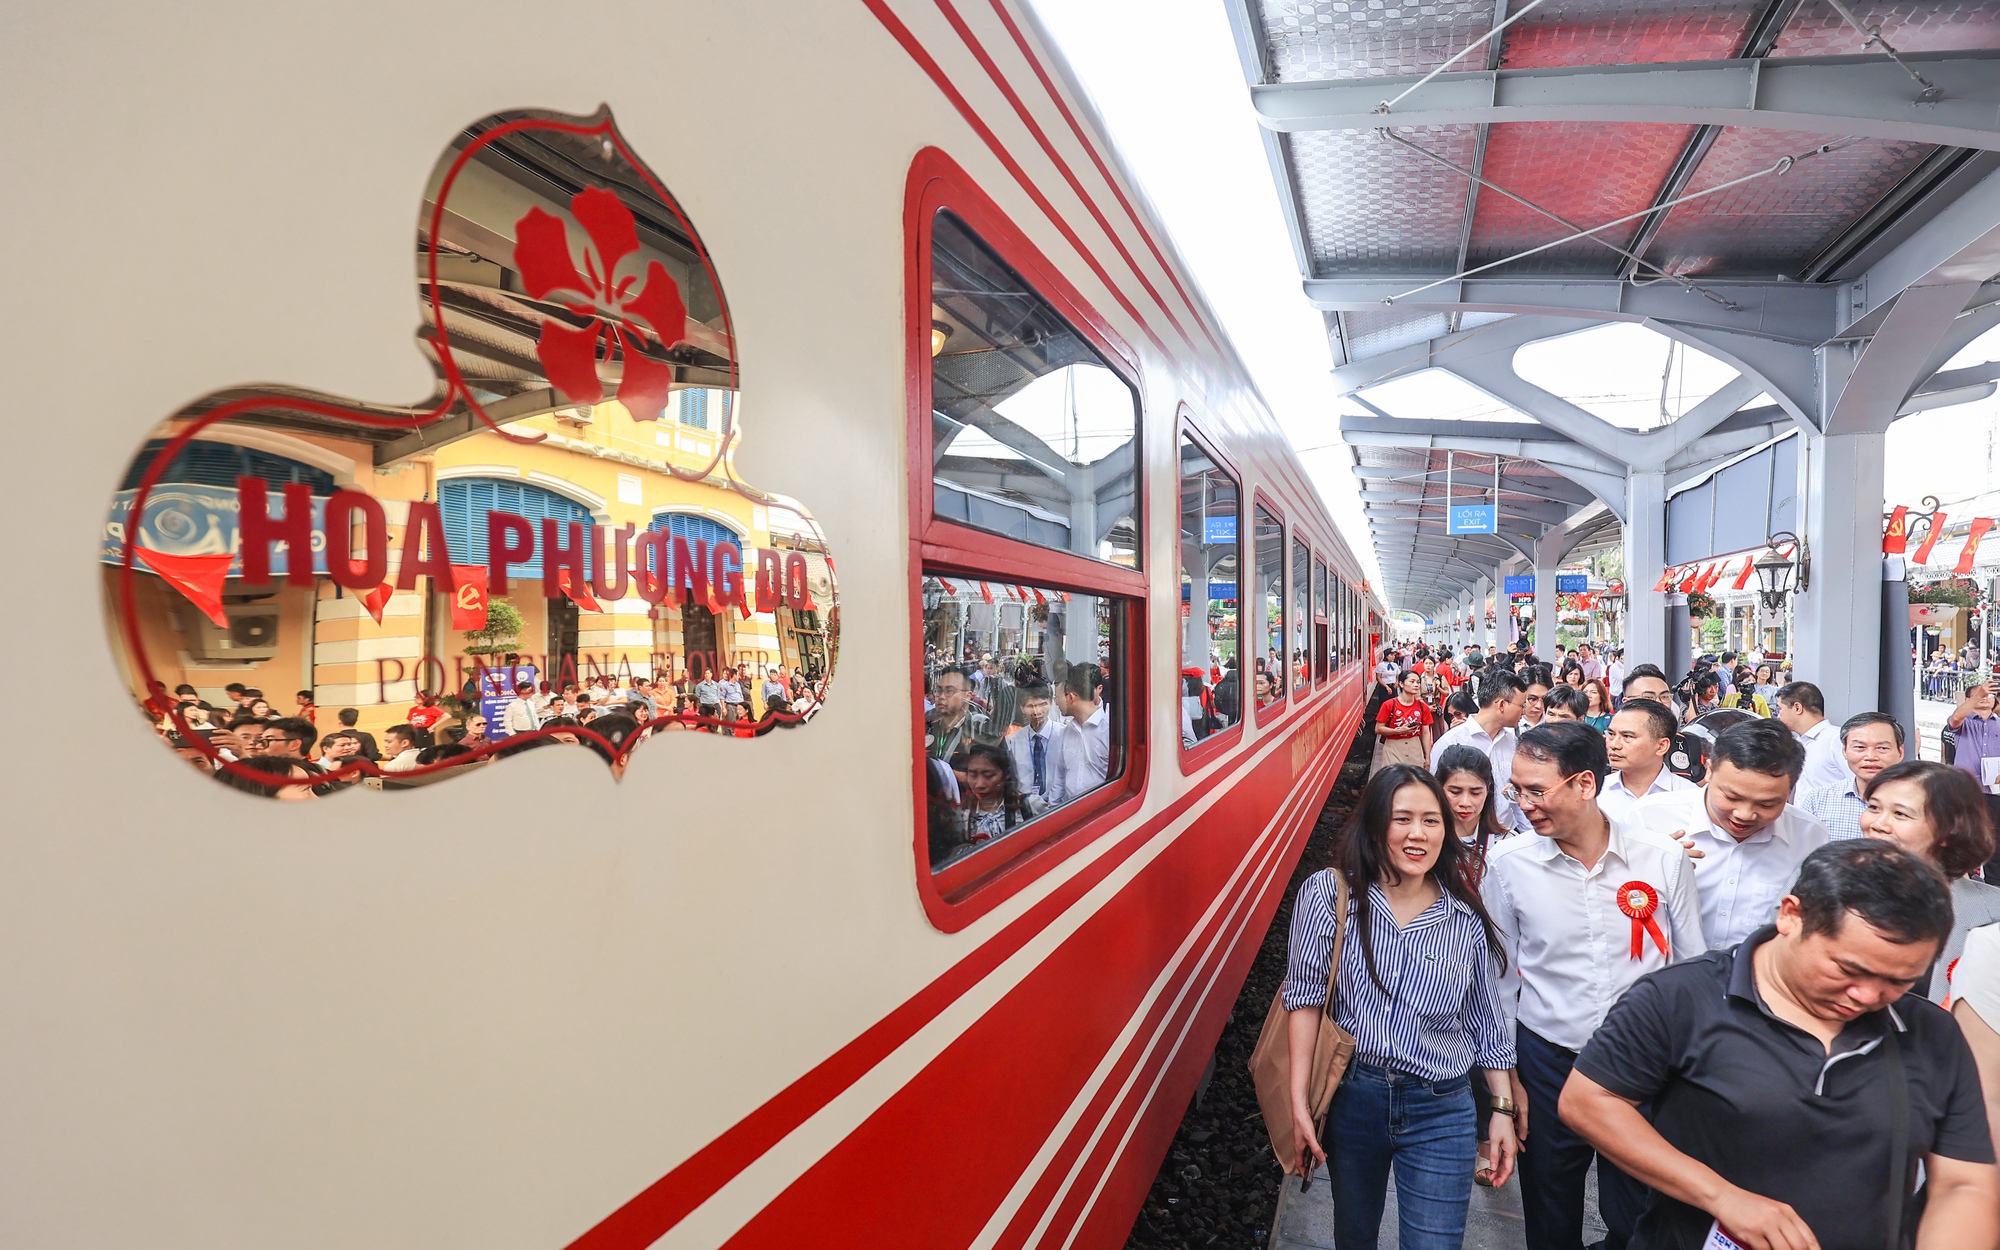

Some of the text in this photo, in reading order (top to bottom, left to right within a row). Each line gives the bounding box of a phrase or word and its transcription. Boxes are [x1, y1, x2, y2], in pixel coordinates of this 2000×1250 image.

[1463, 518, 1481, 526] EXIT
[1474, 510, 1487, 518] RA
[237, 475, 455, 594] HOA
[487, 510, 743, 620] PHƯỢNG
[375, 650, 772, 703] POINCIANA FLOWER
